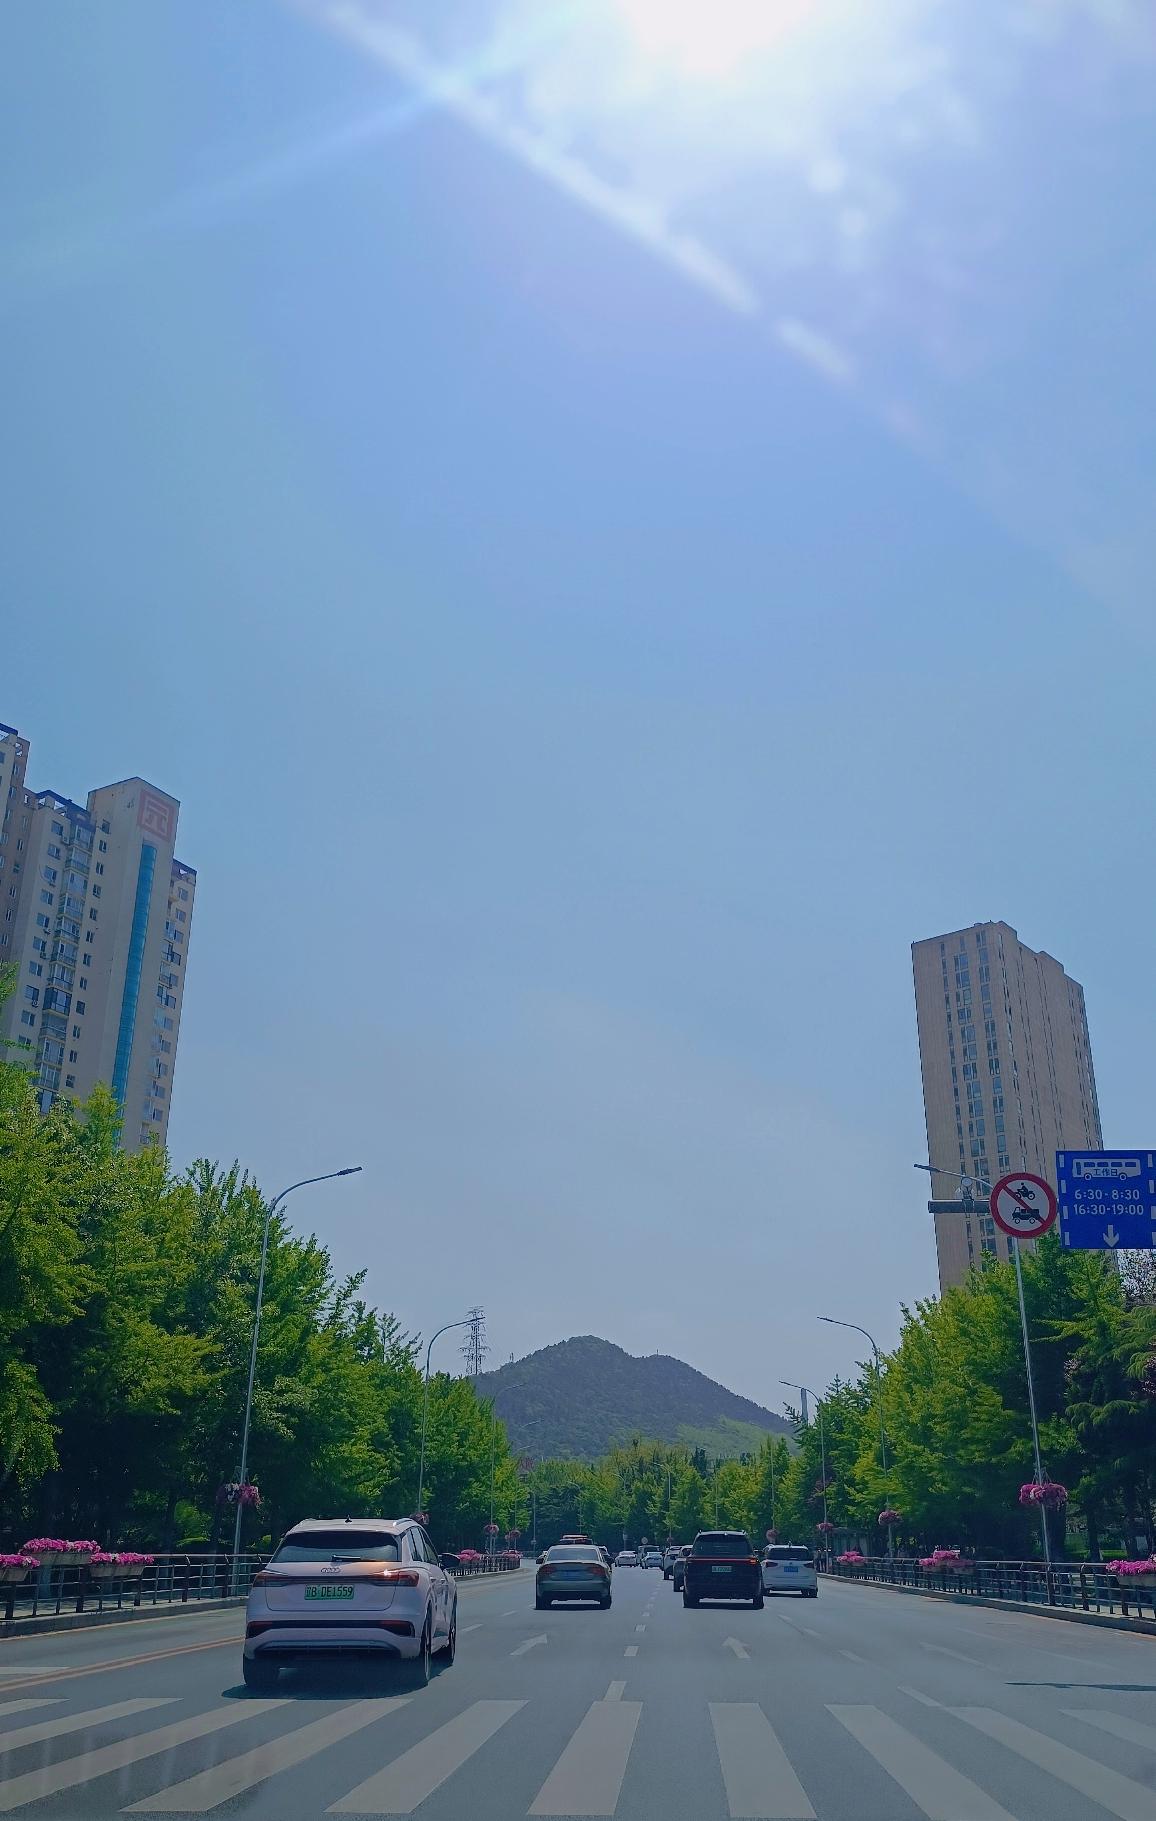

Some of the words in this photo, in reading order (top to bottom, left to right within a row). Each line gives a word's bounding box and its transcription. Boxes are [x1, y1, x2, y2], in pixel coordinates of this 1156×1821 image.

[1093, 1168, 1118, 1176] 工作日
[1074, 1204, 1144, 1215] 16:30-19:00
